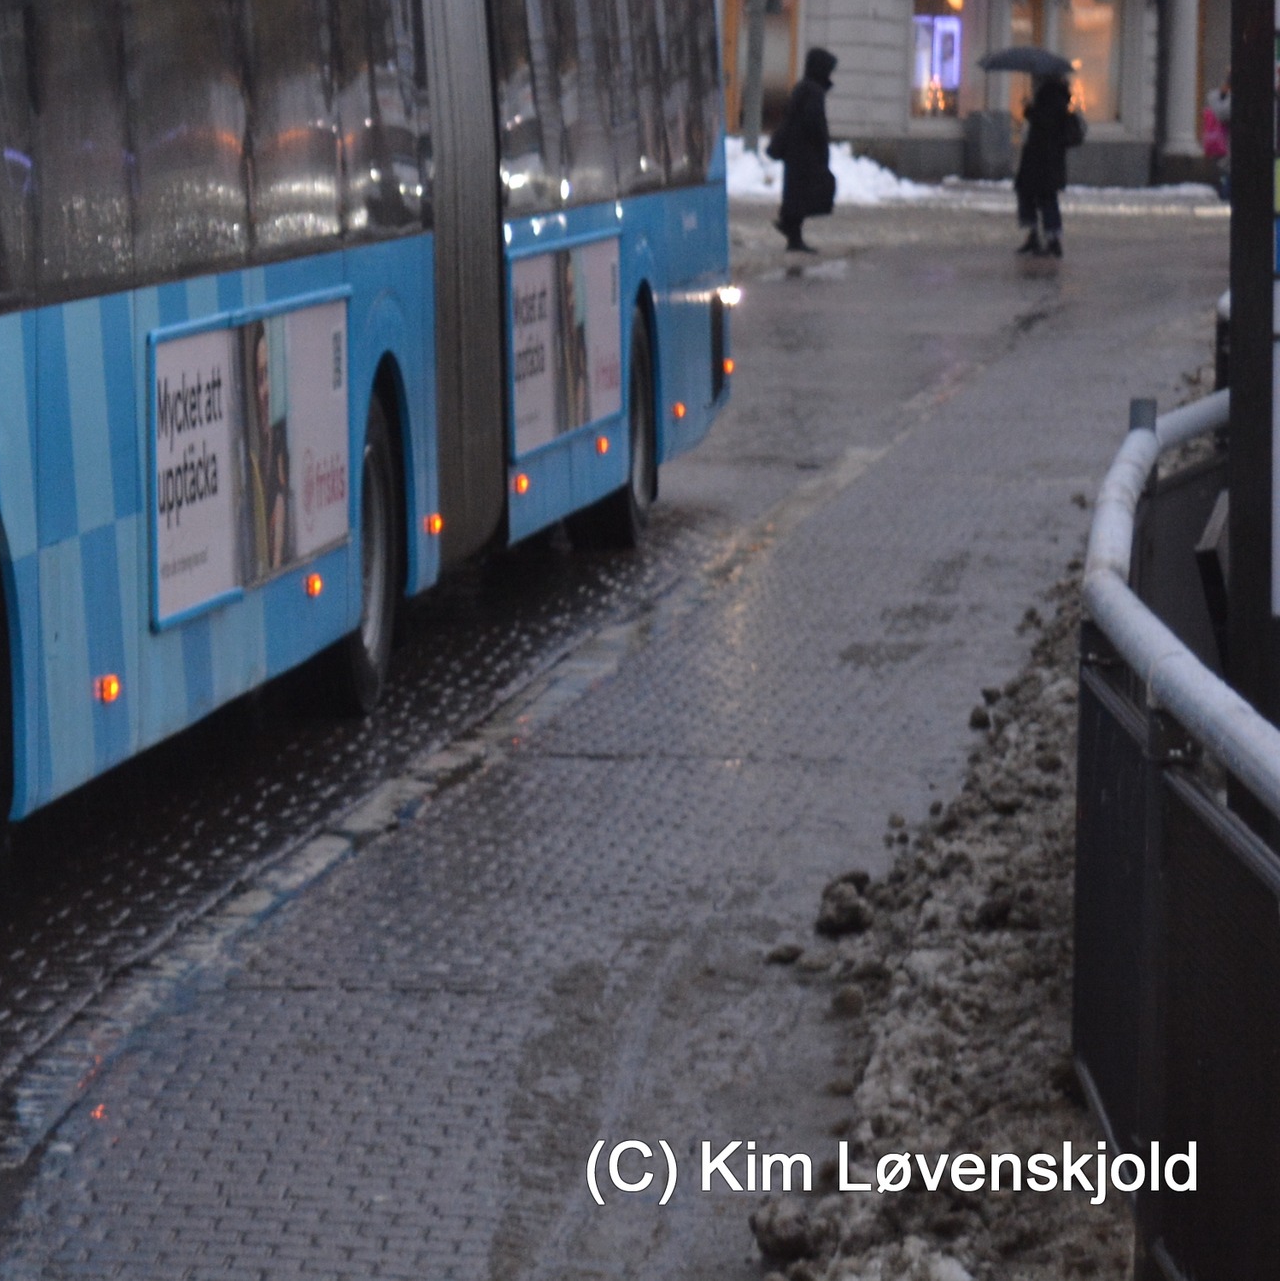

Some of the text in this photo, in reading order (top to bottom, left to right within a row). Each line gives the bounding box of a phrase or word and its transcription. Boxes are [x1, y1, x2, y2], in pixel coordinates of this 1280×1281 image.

[157, 368, 223, 451] Mycket att
[158, 441, 218, 529] upptäcka
